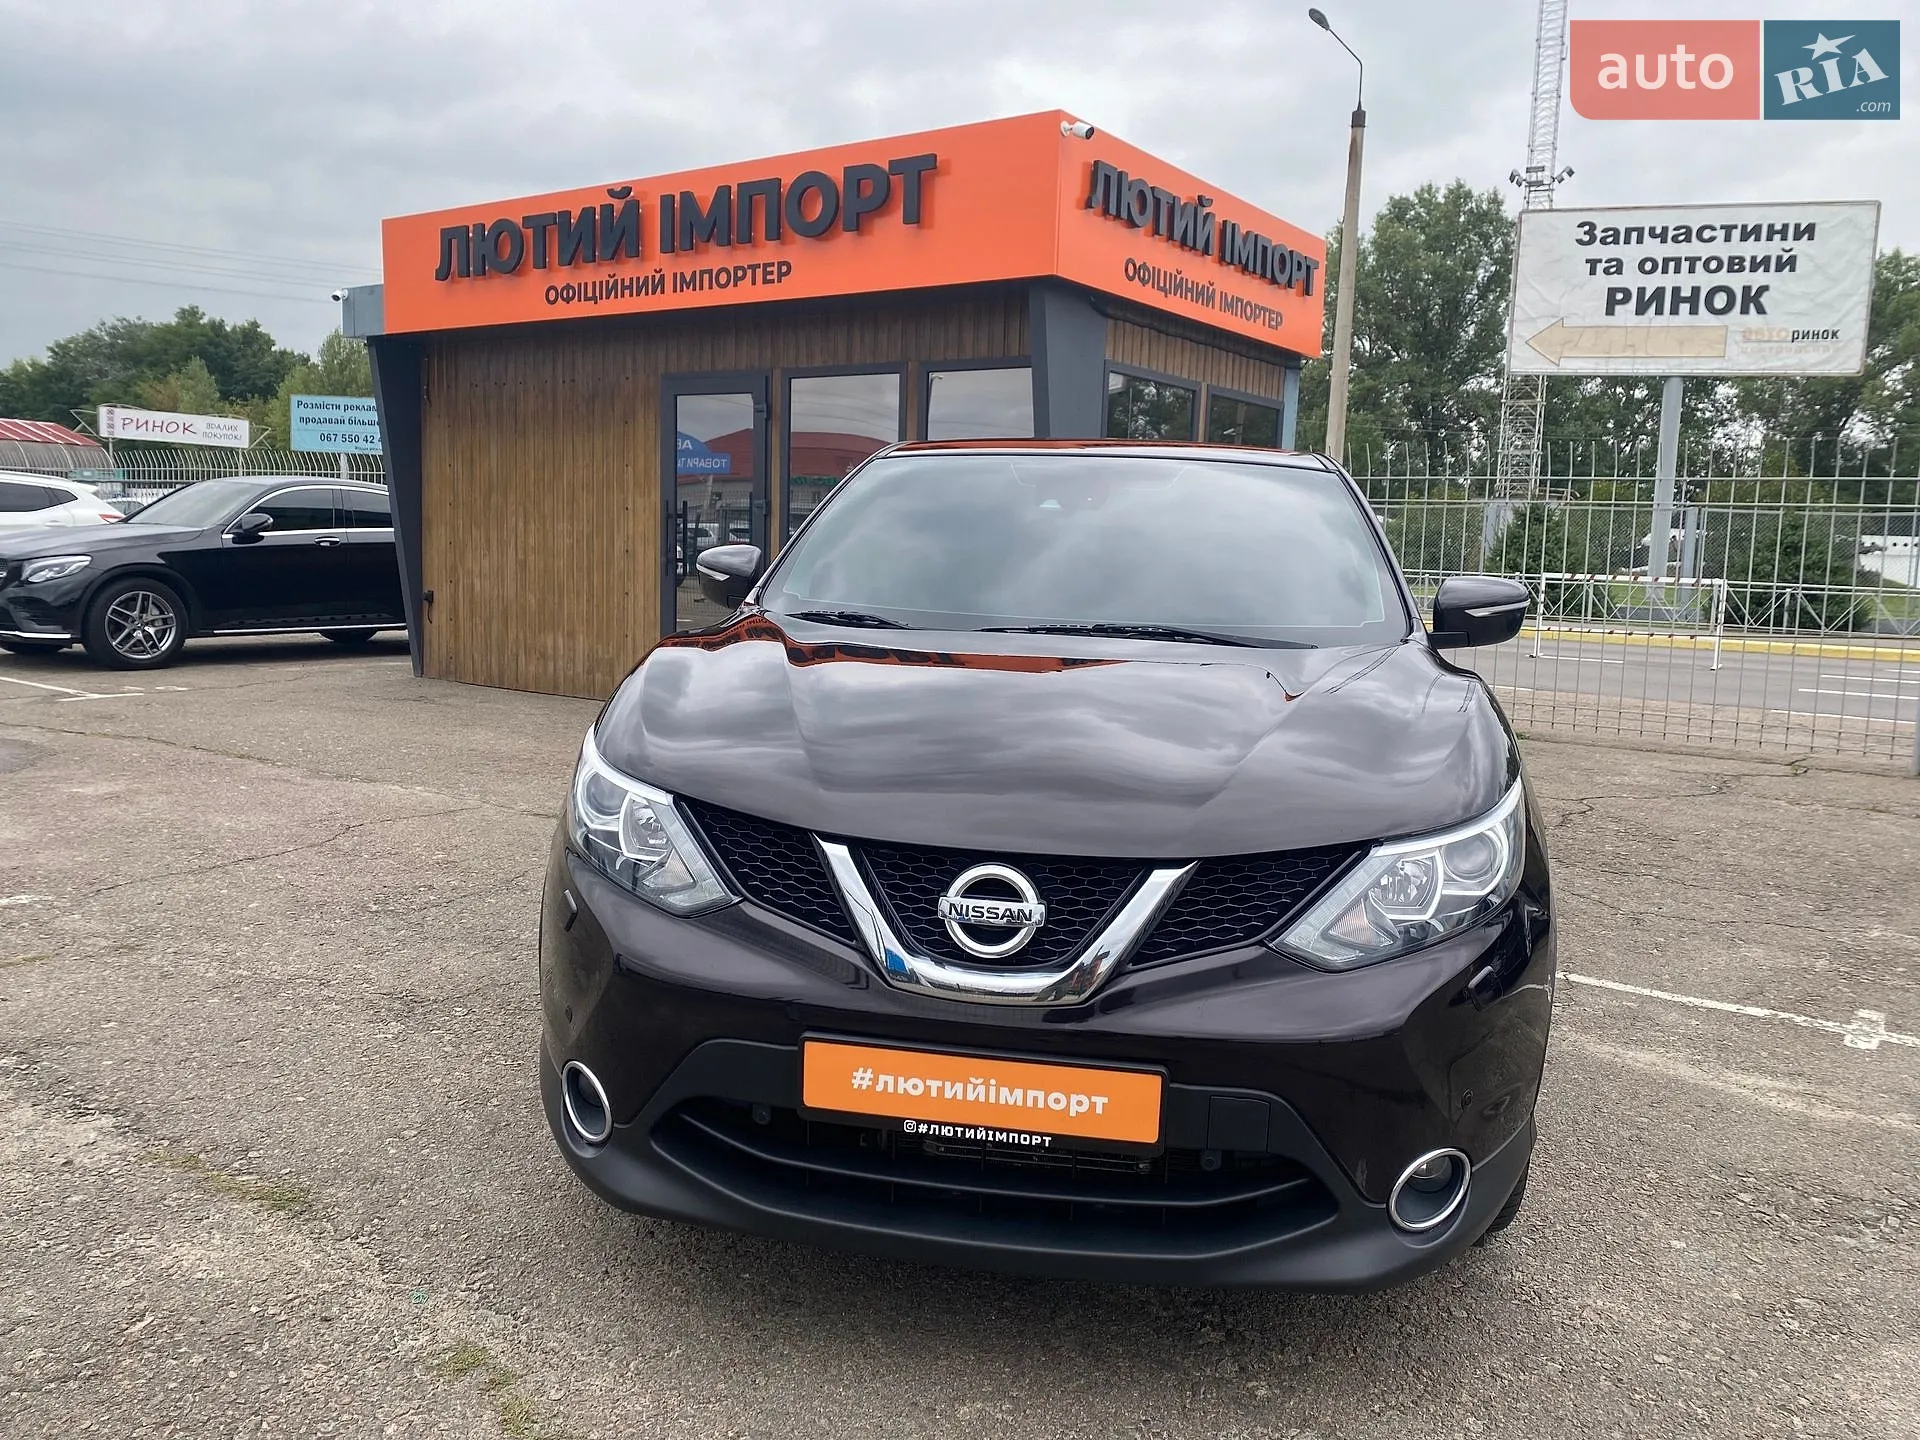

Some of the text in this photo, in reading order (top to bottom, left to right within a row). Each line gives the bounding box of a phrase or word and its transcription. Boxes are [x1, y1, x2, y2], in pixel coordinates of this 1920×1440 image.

[435, 153, 937, 281] ЛЮТИЙ ІМПОРТ
[1086, 159, 1319, 296] ЛЮТИЙ ІМПОРТ
[1575, 220, 1816, 246] Запчастини
[1585, 247, 1798, 276] та оптовий
[544, 260, 792, 305] ОФІЦІЙНИЙ ІМПОРТЕР
[1124, 257, 1283, 331] ОФІЦІЙНИЙ ІМПОРТЕР
[1605, 284, 1770, 316] РИНОК
[296, 399, 340, 411] Розмісти
[120, 417, 197, 435] РИНОК
[299, 416, 345, 425] продавай
[320, 433, 338, 442] 067
[341, 433, 360, 443] 550
[362, 434, 375, 444] 42
[948, 902, 1033, 923] NISSAN
[851, 1066, 1109, 1117] #лютийімпорт
